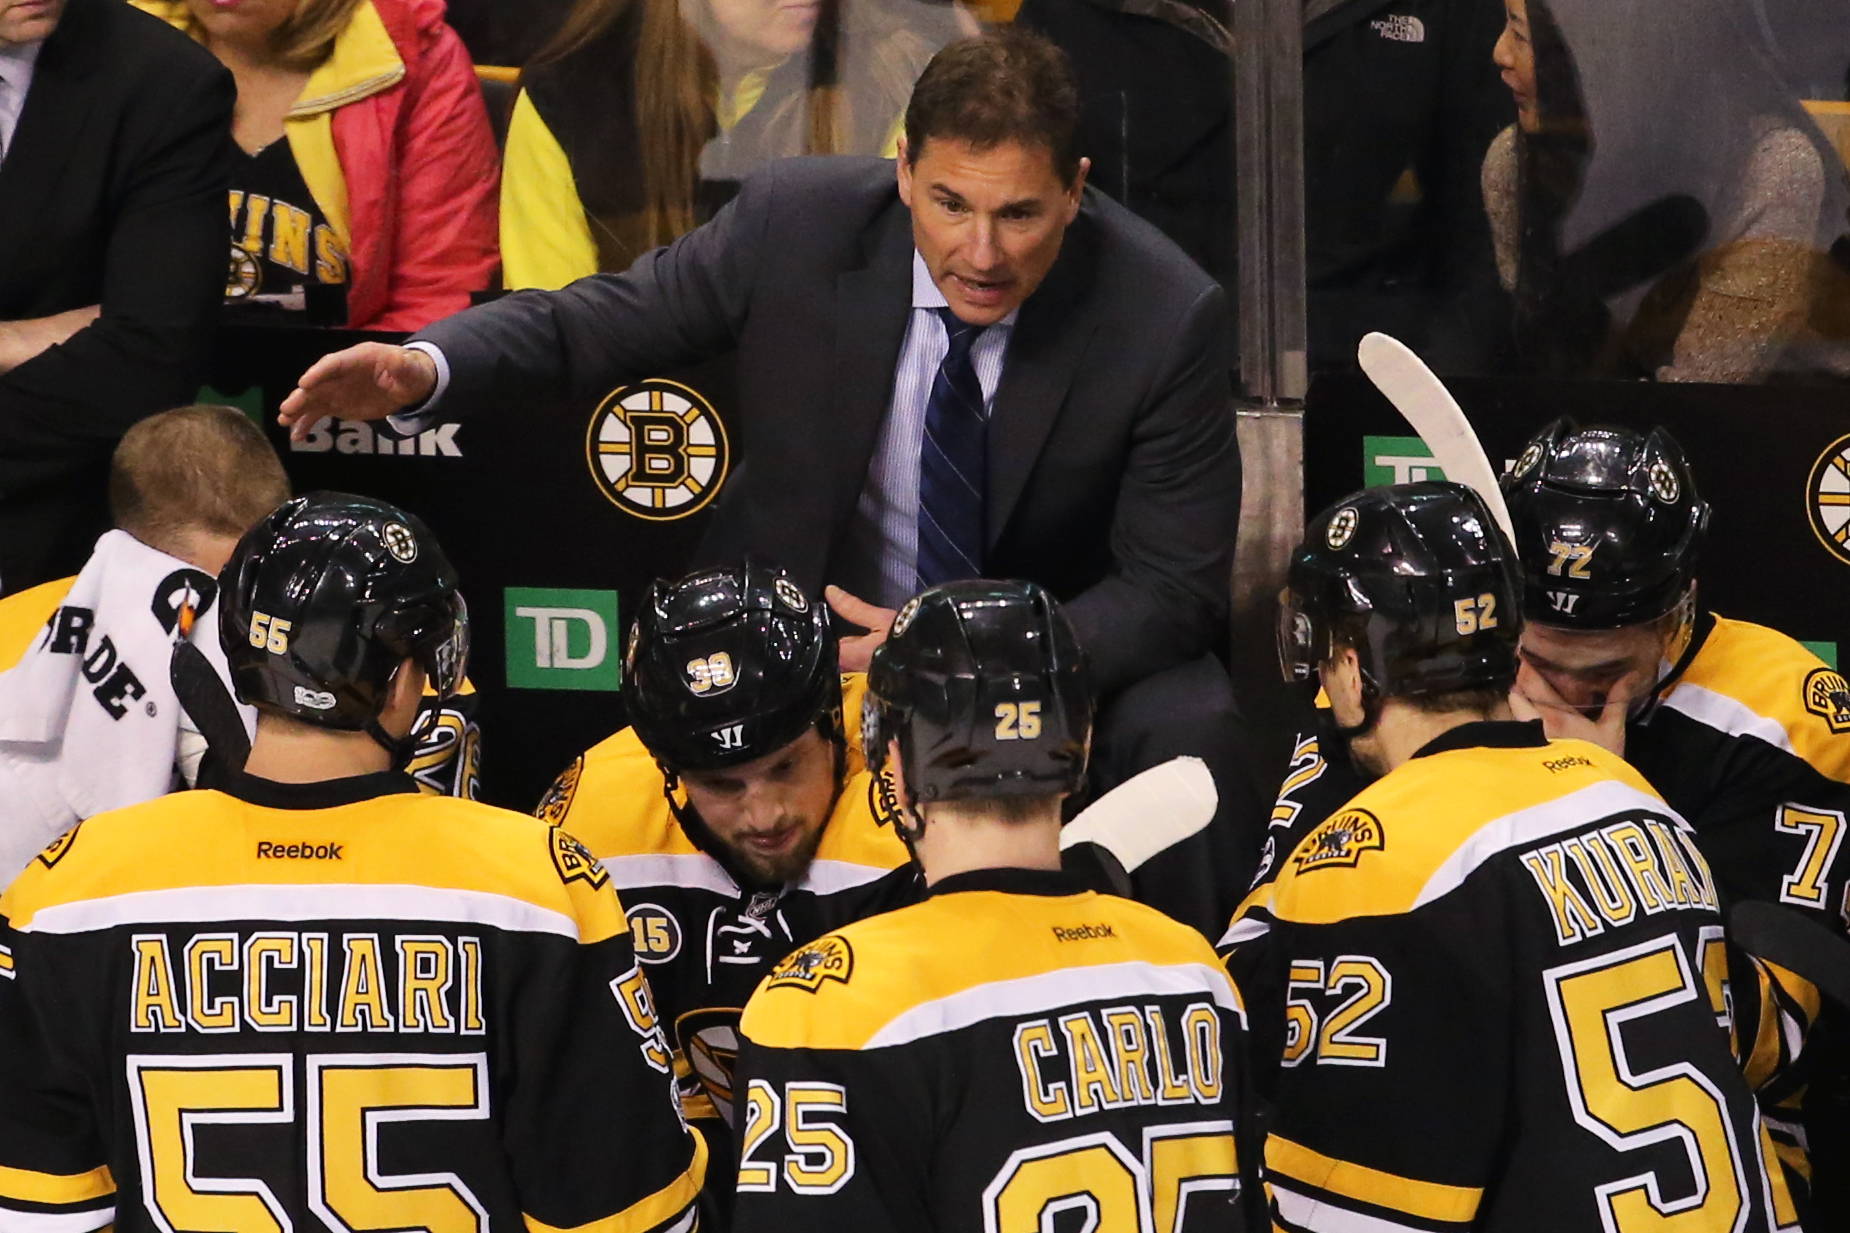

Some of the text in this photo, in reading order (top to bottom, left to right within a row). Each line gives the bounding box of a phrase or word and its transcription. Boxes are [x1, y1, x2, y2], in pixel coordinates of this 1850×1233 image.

[1370, 20, 1408, 34] NORTH
[1380, 28, 1409, 41] FACE
[1388, 14, 1408, 25] THE
[228, 189, 348, 285] INS
[1547, 541, 1593, 580] 72
[249, 610, 292, 655] 55
[1454, 592, 1498, 635] 52
[515, 606, 608, 669] TD
[994, 700, 1042, 740] 25
[1542, 754, 1596, 774] Reebok
[257, 841, 344, 860] Reebok
[631, 916, 671, 953] 15
[1052, 922, 1118, 943] Reebok
[130, 932, 487, 1036] ACCIARI
[1280, 955, 1393, 1069] 52
[1012, 1002, 1223, 1124] CARLO
[126, 1052, 491, 1233] 55
[735, 1078, 856, 1196] 25
